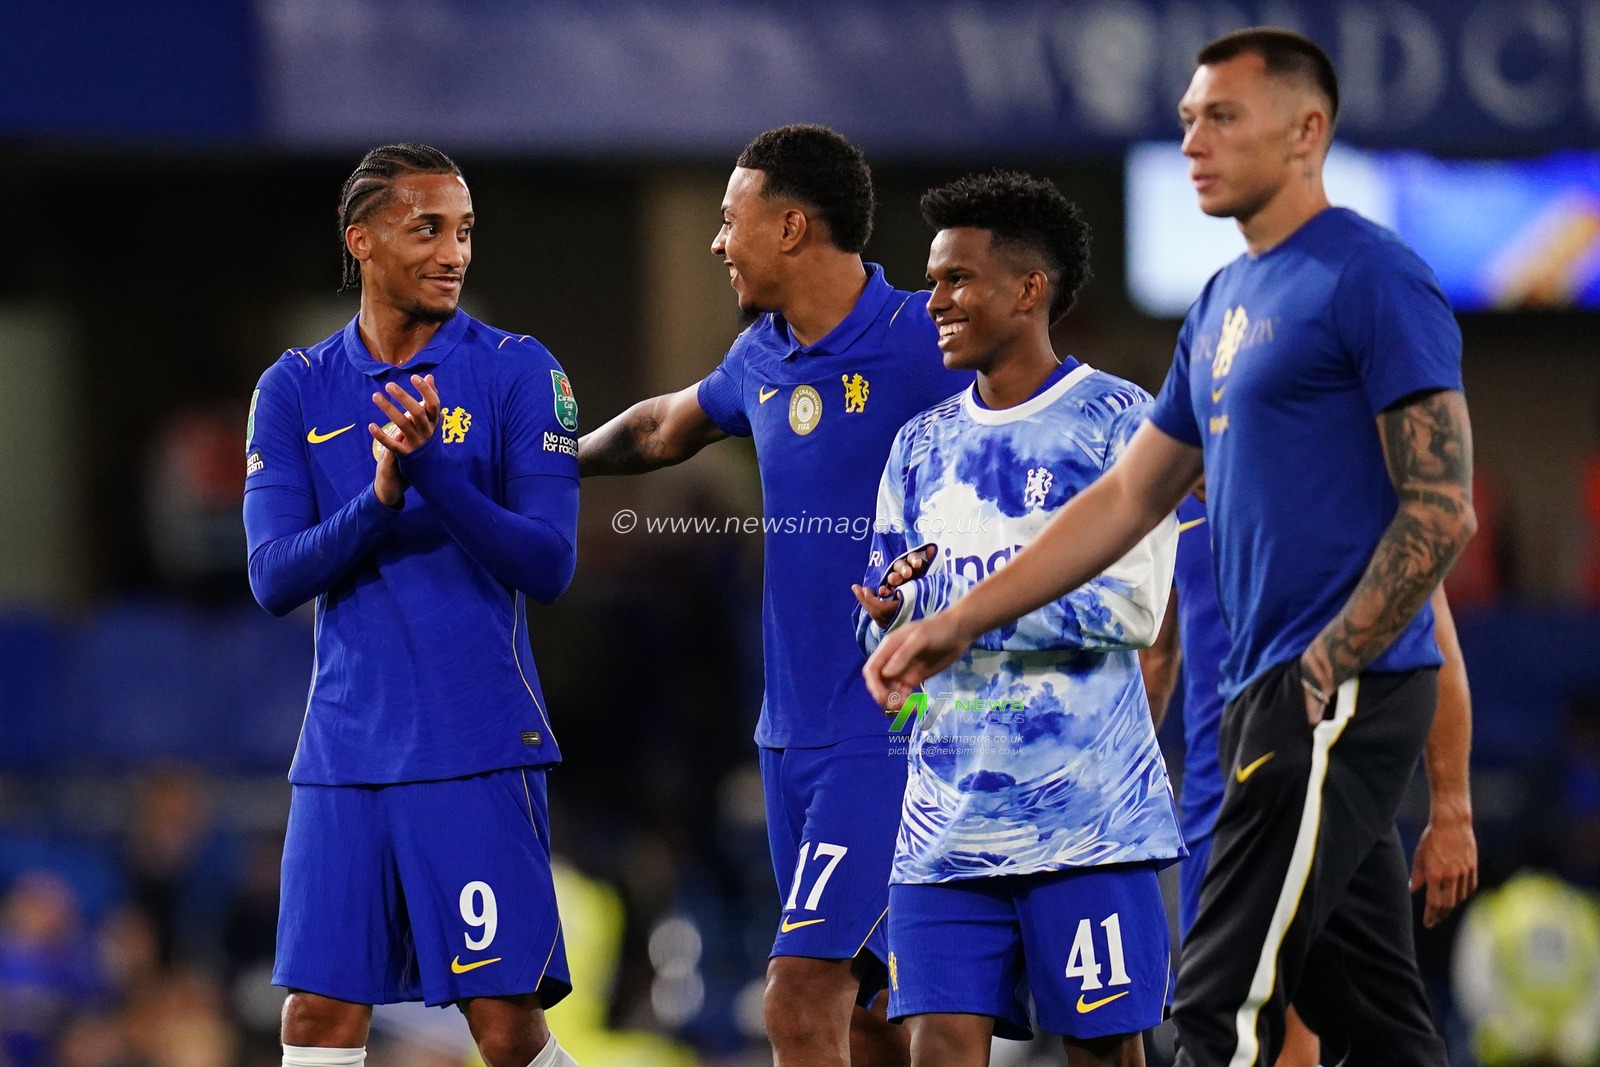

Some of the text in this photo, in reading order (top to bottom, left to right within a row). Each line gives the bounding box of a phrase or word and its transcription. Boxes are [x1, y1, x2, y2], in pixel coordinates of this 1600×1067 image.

[544, 431, 559, 443] No
[558, 444, 578, 459] racis
[785, 842, 848, 911] 17
[459, 880, 498, 951] 9
[1065, 912, 1132, 991] 41
